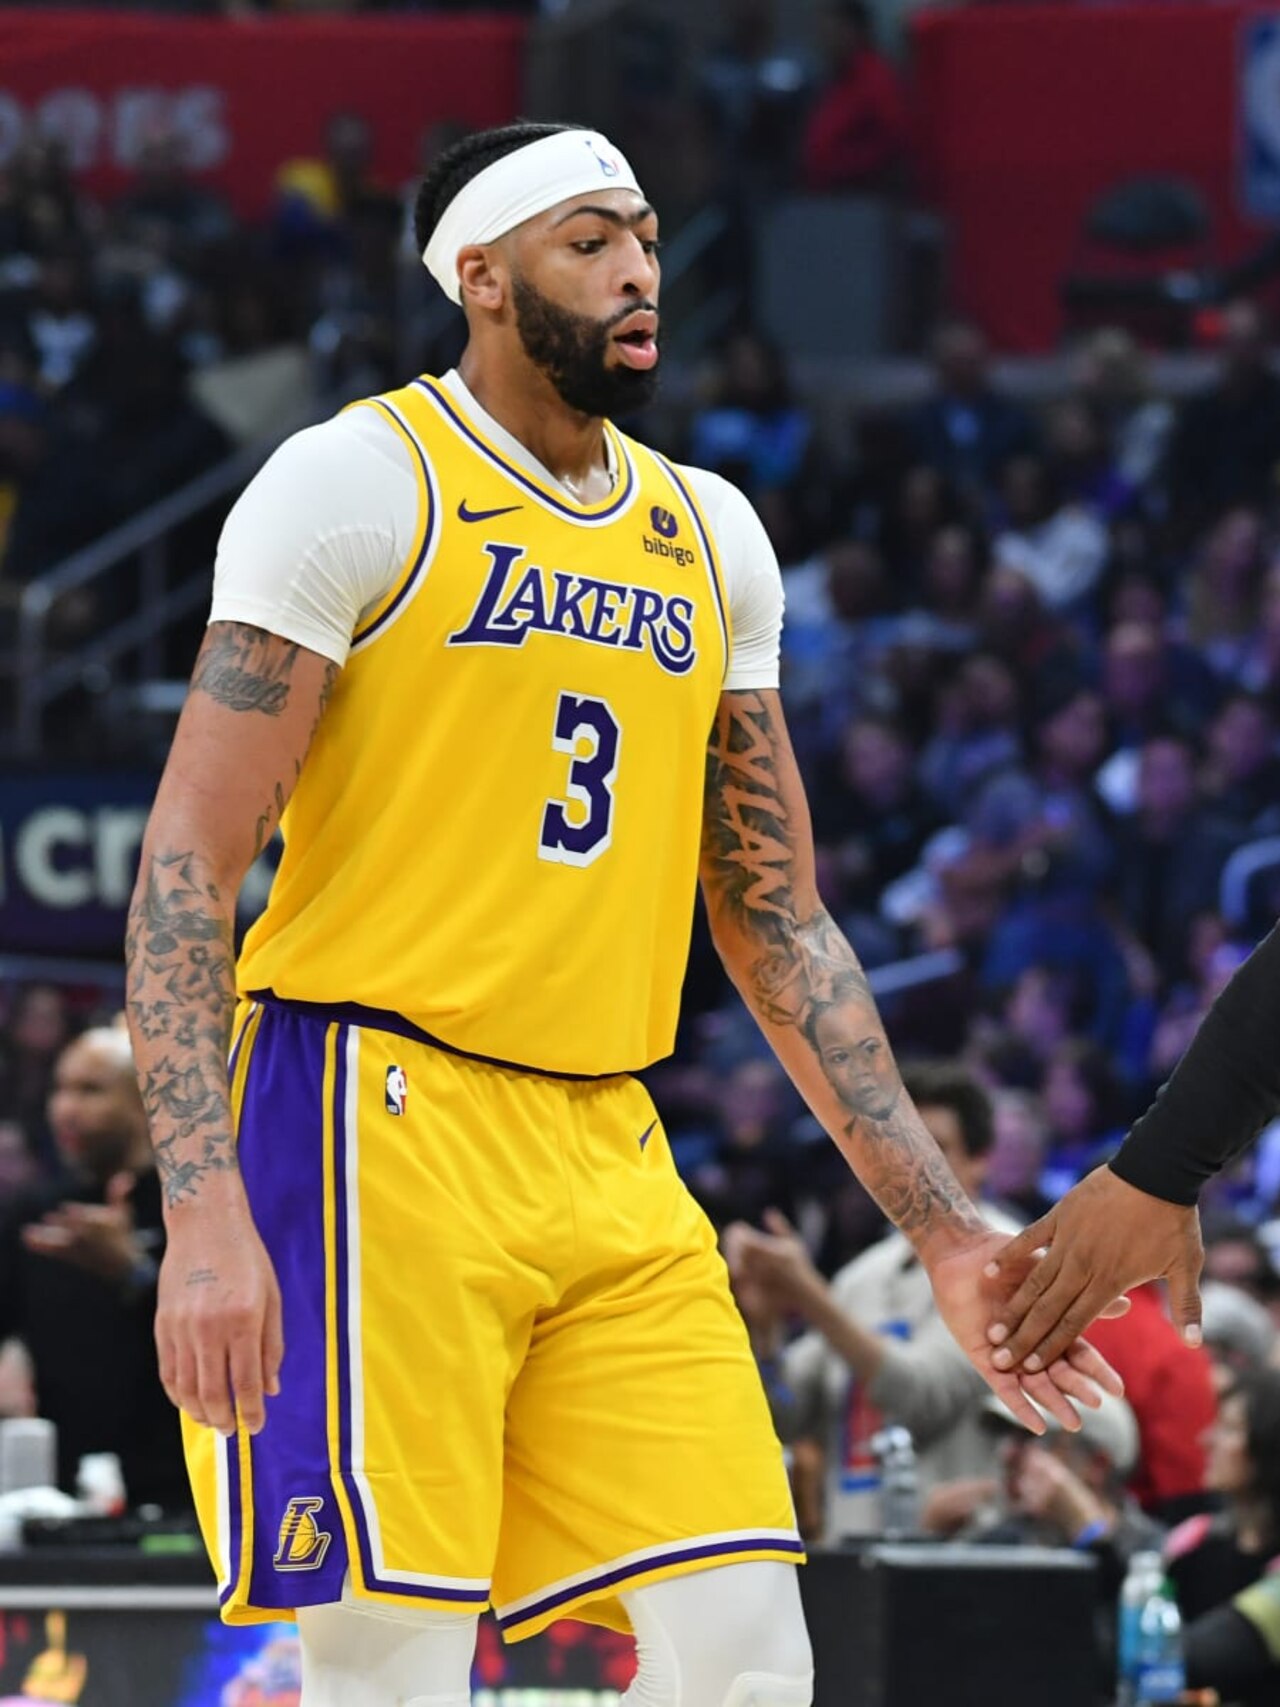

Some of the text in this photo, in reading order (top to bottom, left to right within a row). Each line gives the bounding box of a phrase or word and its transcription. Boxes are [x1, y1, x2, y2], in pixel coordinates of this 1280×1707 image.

[446, 542, 697, 676] LAKERS
[642, 534, 695, 567] bibigo
[537, 689, 623, 869] 3
